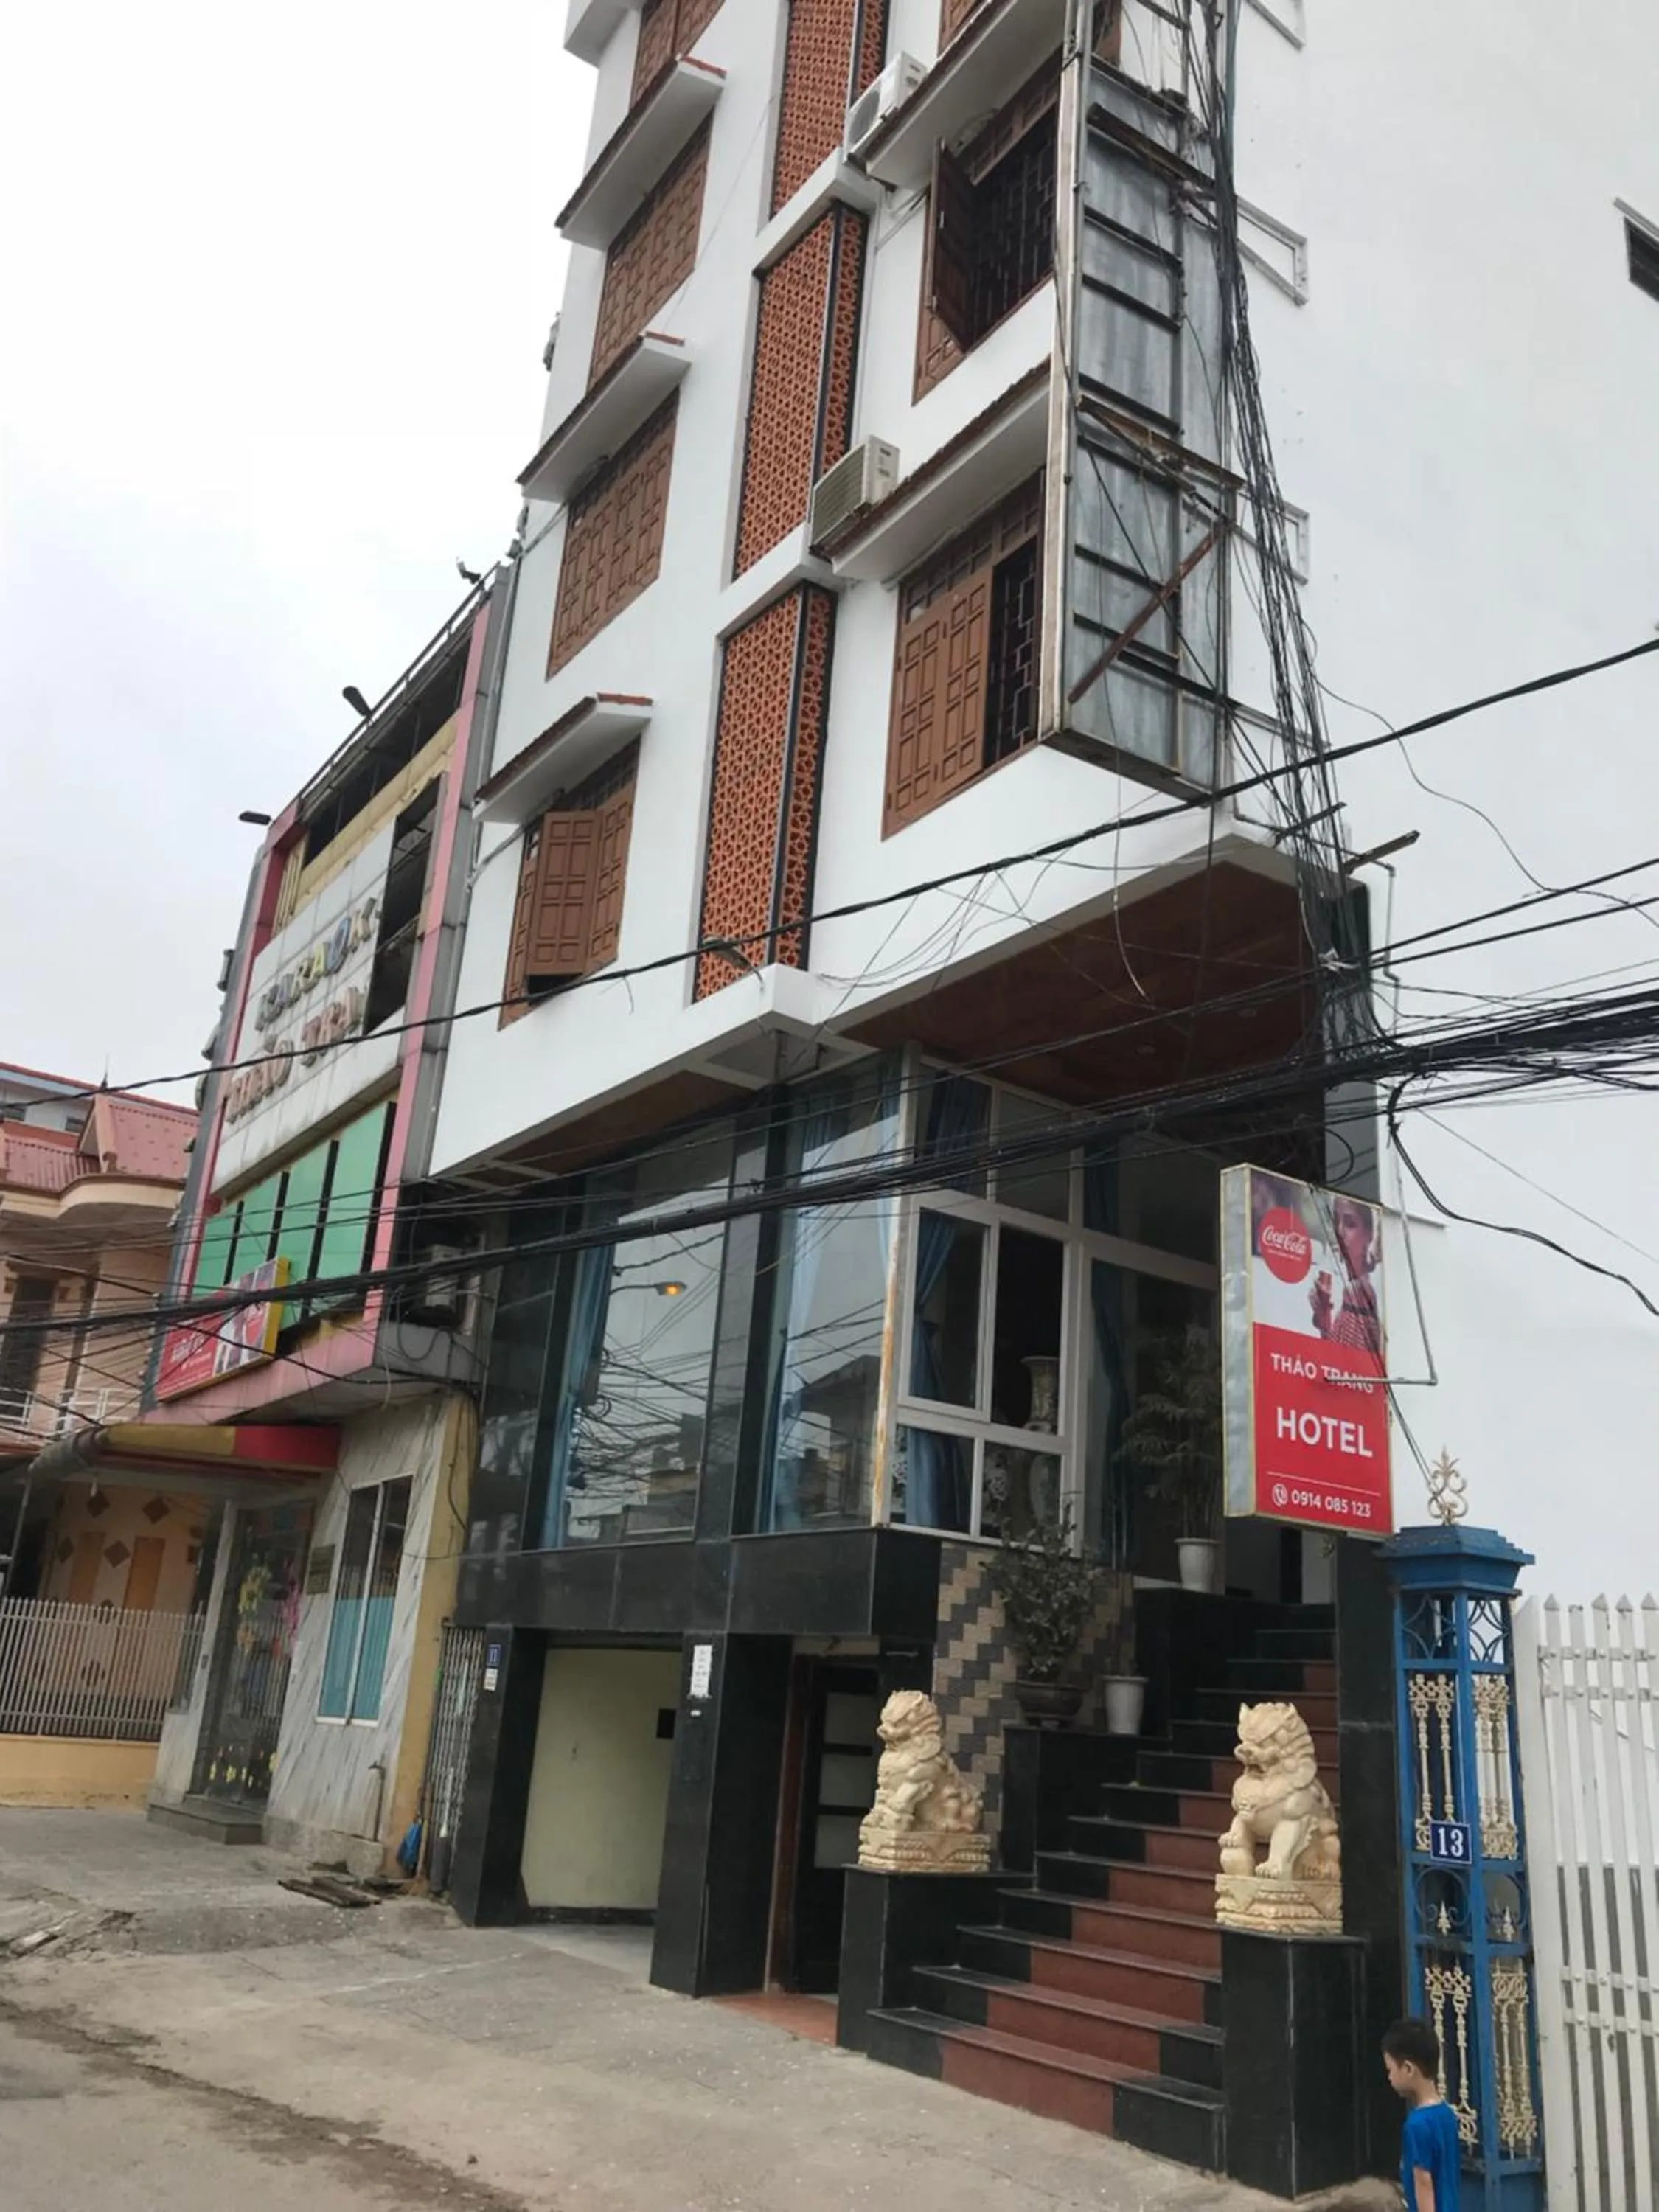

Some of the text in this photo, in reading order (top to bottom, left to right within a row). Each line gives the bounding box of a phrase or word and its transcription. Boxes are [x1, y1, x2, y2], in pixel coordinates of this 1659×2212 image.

[1277, 1406, 1373, 1458] HOTEL
[1291, 1489, 1371, 1517] 0914 085 123
[1439, 1827, 1464, 1857] 13
